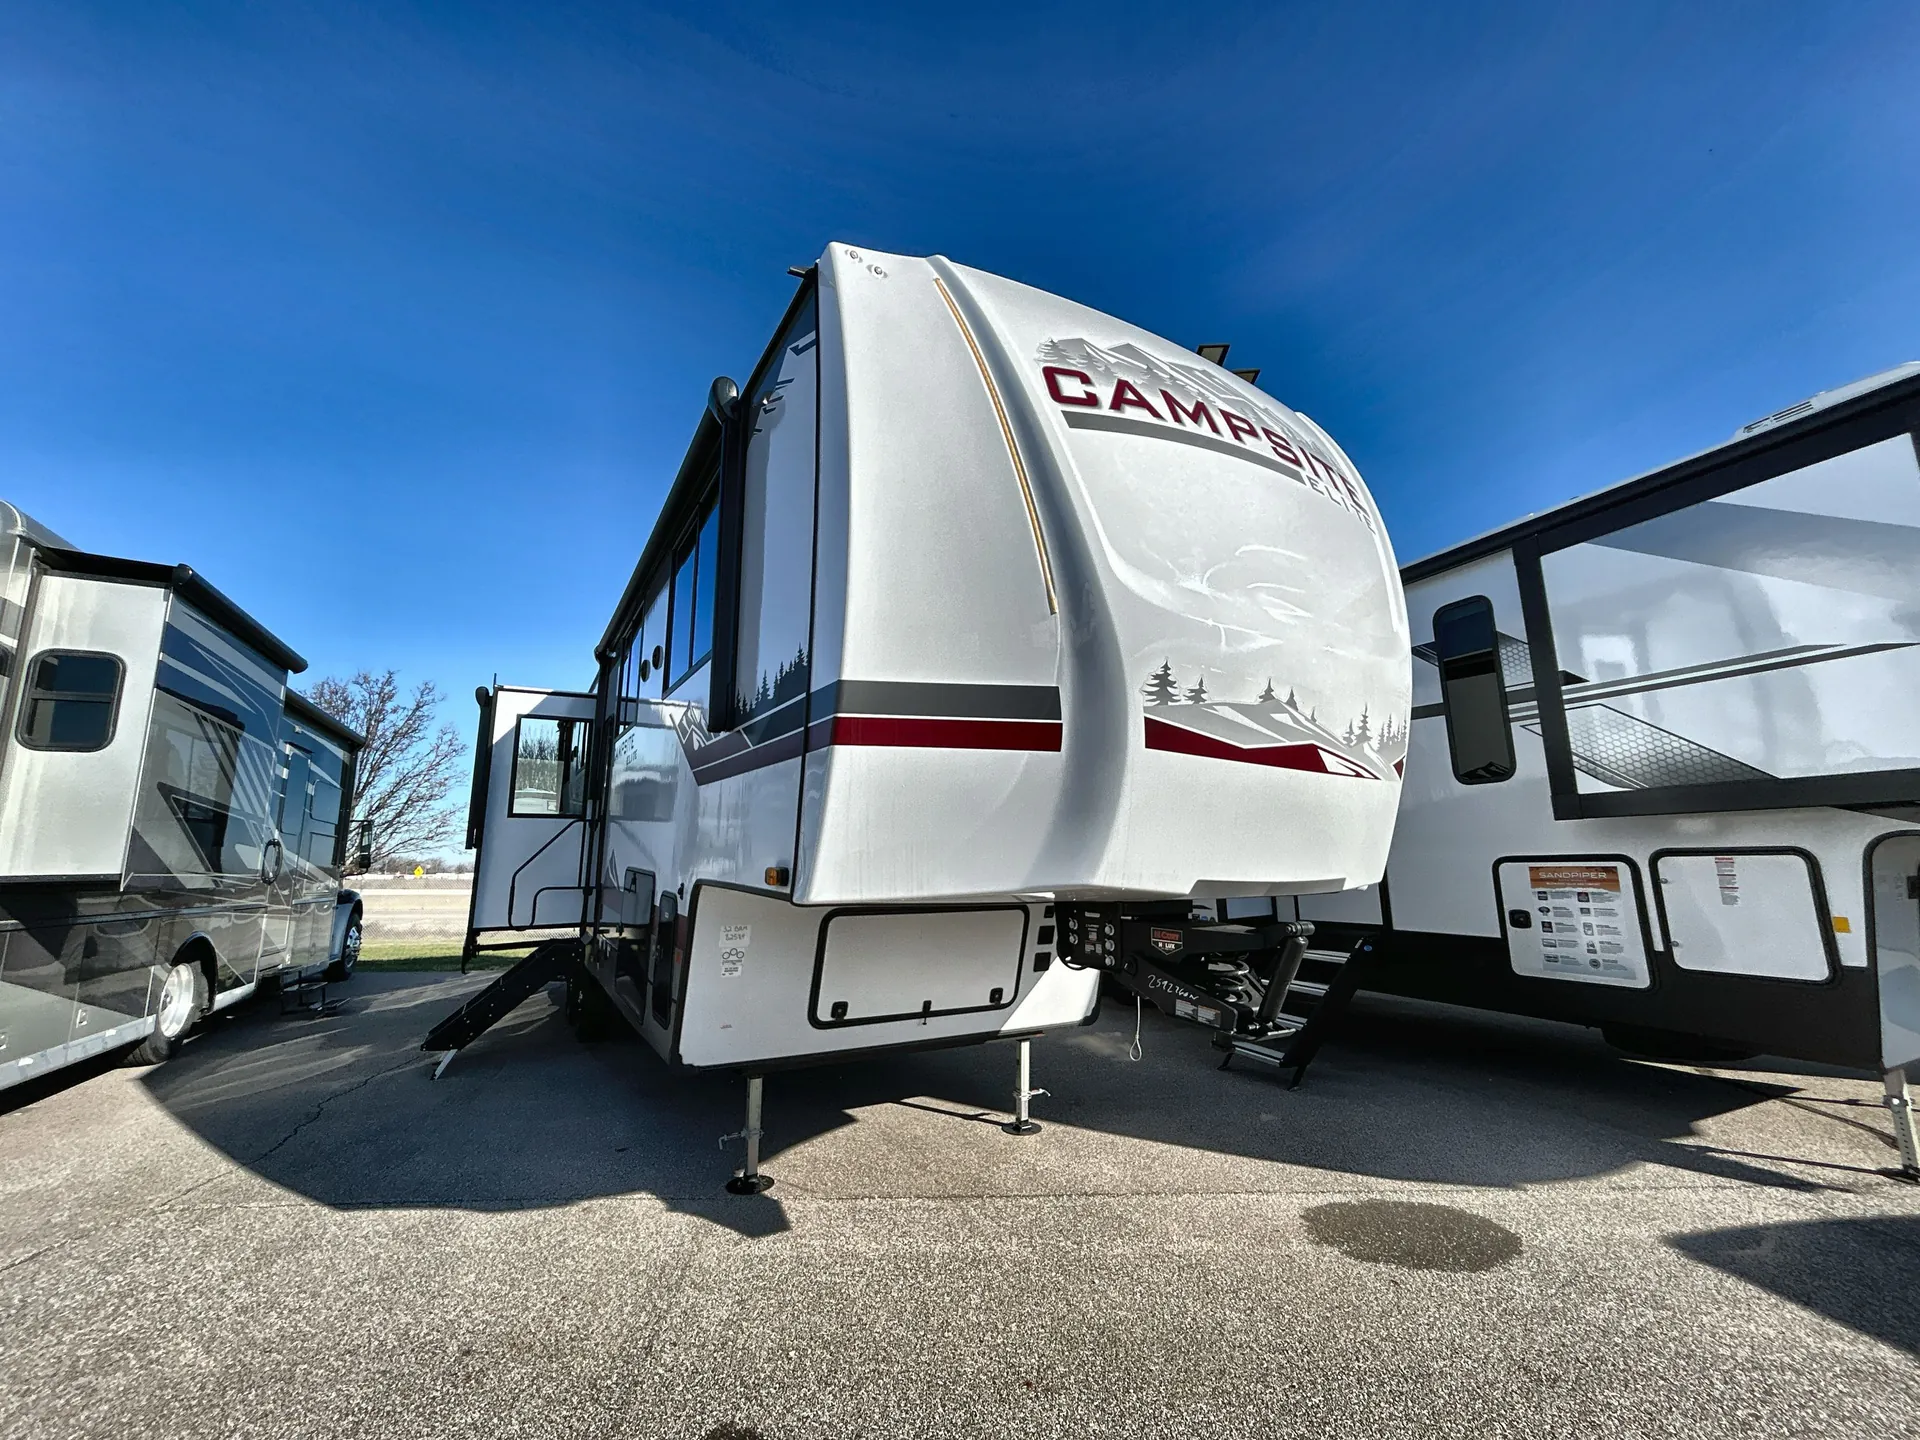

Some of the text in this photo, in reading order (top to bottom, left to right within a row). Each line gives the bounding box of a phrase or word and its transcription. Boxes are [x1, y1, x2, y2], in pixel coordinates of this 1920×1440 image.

[1042, 366, 1369, 518] CAMPSITE
[1306, 475, 1376, 535] ELITE
[1538, 871, 1607, 879] SANDPIPER
